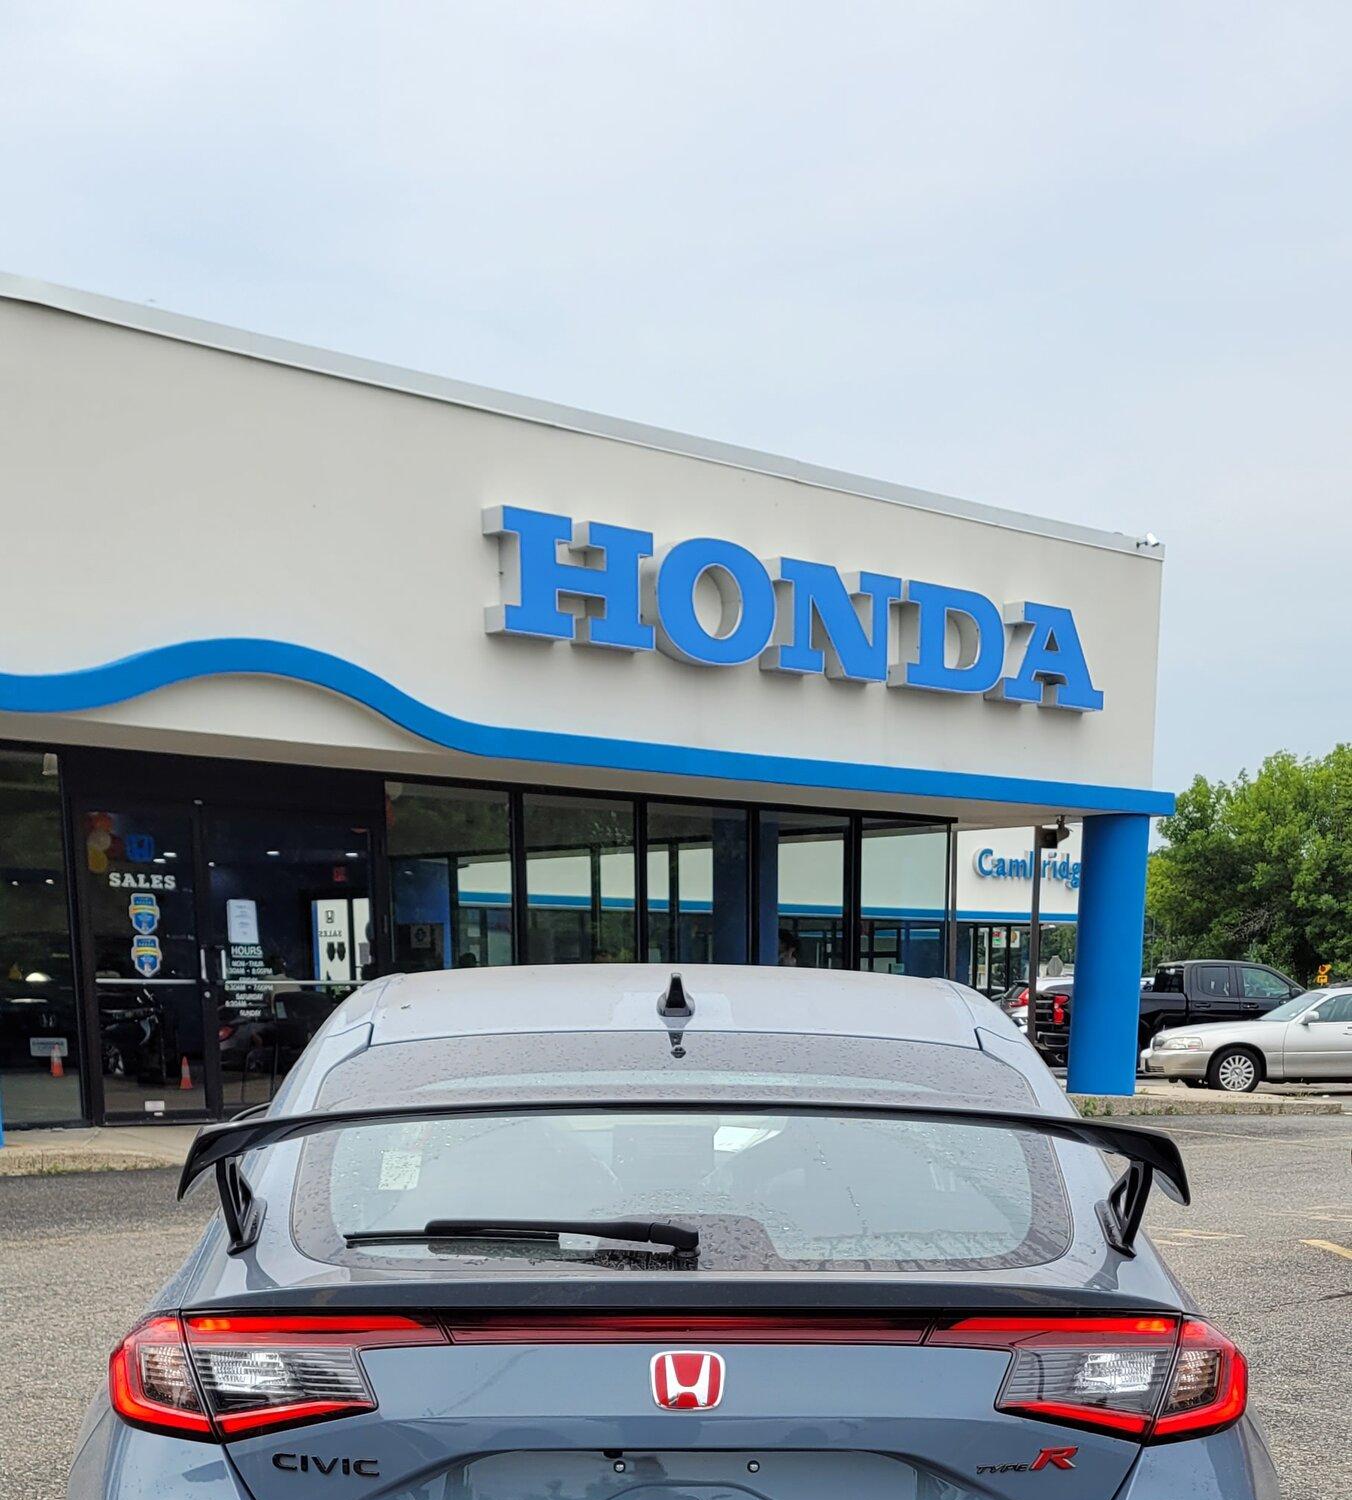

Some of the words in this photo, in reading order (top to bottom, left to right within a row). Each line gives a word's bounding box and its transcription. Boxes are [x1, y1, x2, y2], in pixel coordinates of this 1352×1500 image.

[498, 504, 1104, 712] HONDA
[109, 872, 176, 890] SALES
[231, 946, 262, 955] HOURS
[240, 1009, 262, 1017] SUNDAY
[272, 1453, 379, 1477] CIVIC
[976, 1463, 1030, 1475] TYPE
[1030, 1445, 1079, 1471] R
